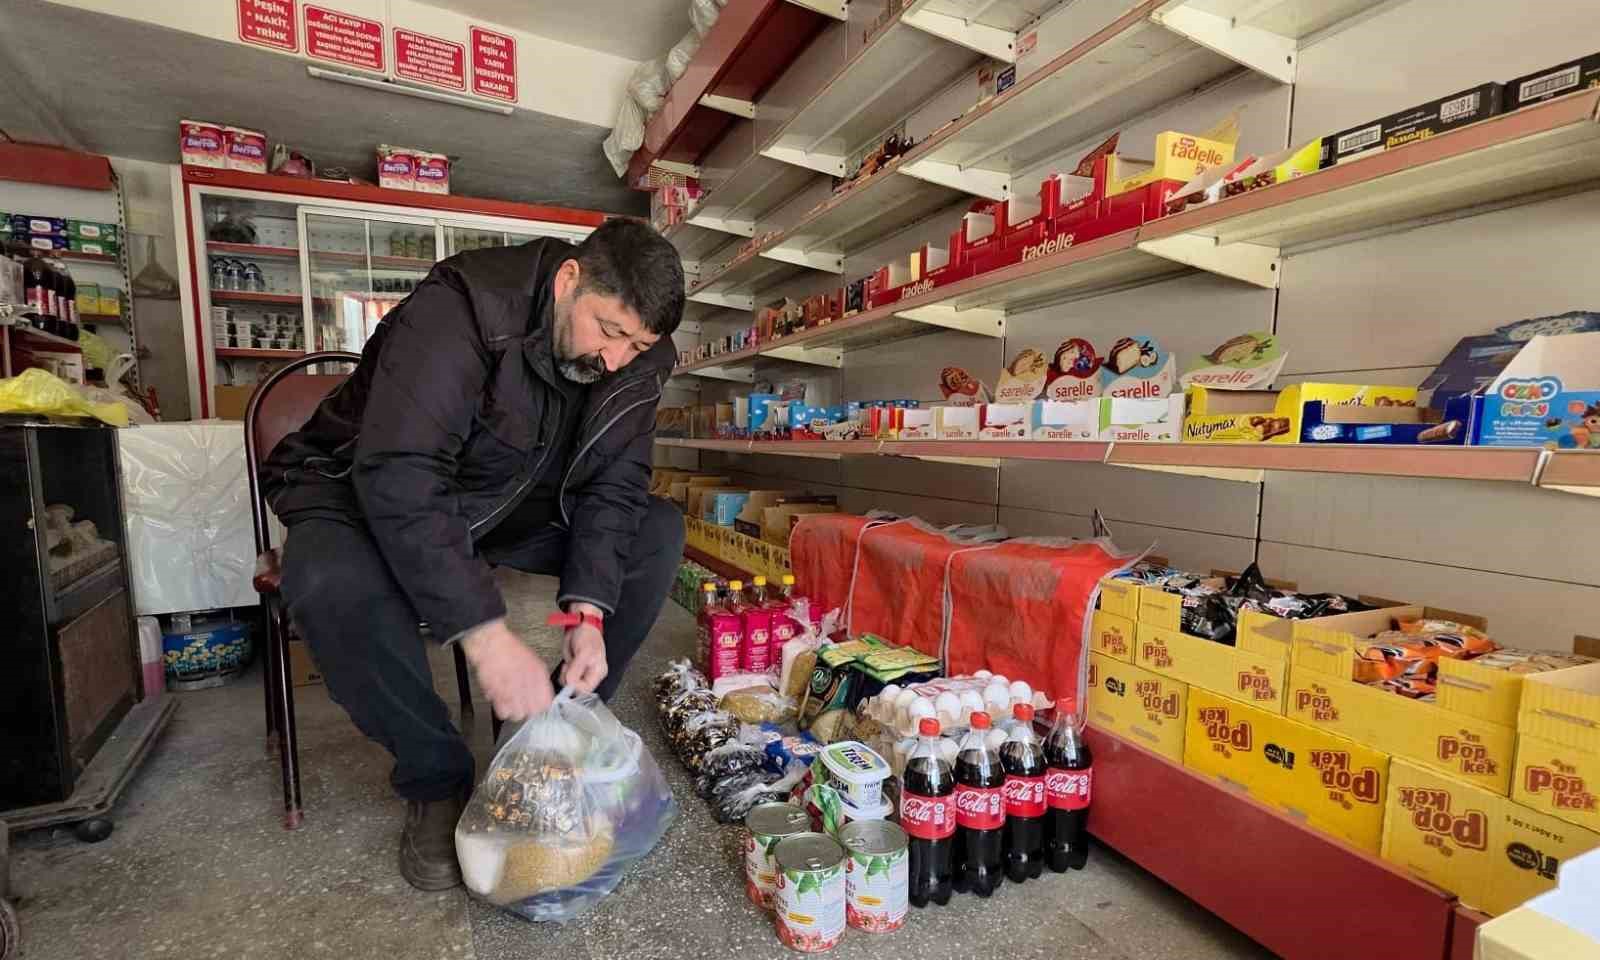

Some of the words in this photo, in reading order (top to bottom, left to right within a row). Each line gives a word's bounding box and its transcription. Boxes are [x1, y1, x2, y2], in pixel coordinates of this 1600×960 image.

[1171, 141, 1224, 166] tadelle
[1022, 233, 1074, 262] tadelle
[902, 278, 935, 300] tadelle
[1192, 370, 1254, 384] sarelle
[1000, 383, 1034, 398] sarelle
[1056, 381, 1094, 398] sarelle
[1048, 429, 1073, 439] sarelle
[1117, 429, 1150, 441] sarelle
[1187, 418, 1236, 440] Nutymax
[1313, 705, 1339, 720] kek
[1311, 750, 1349, 770] kek
[1462, 759, 1497, 775] kek
[1400, 788, 1449, 811] kek
[904, 798, 935, 822] Cola
